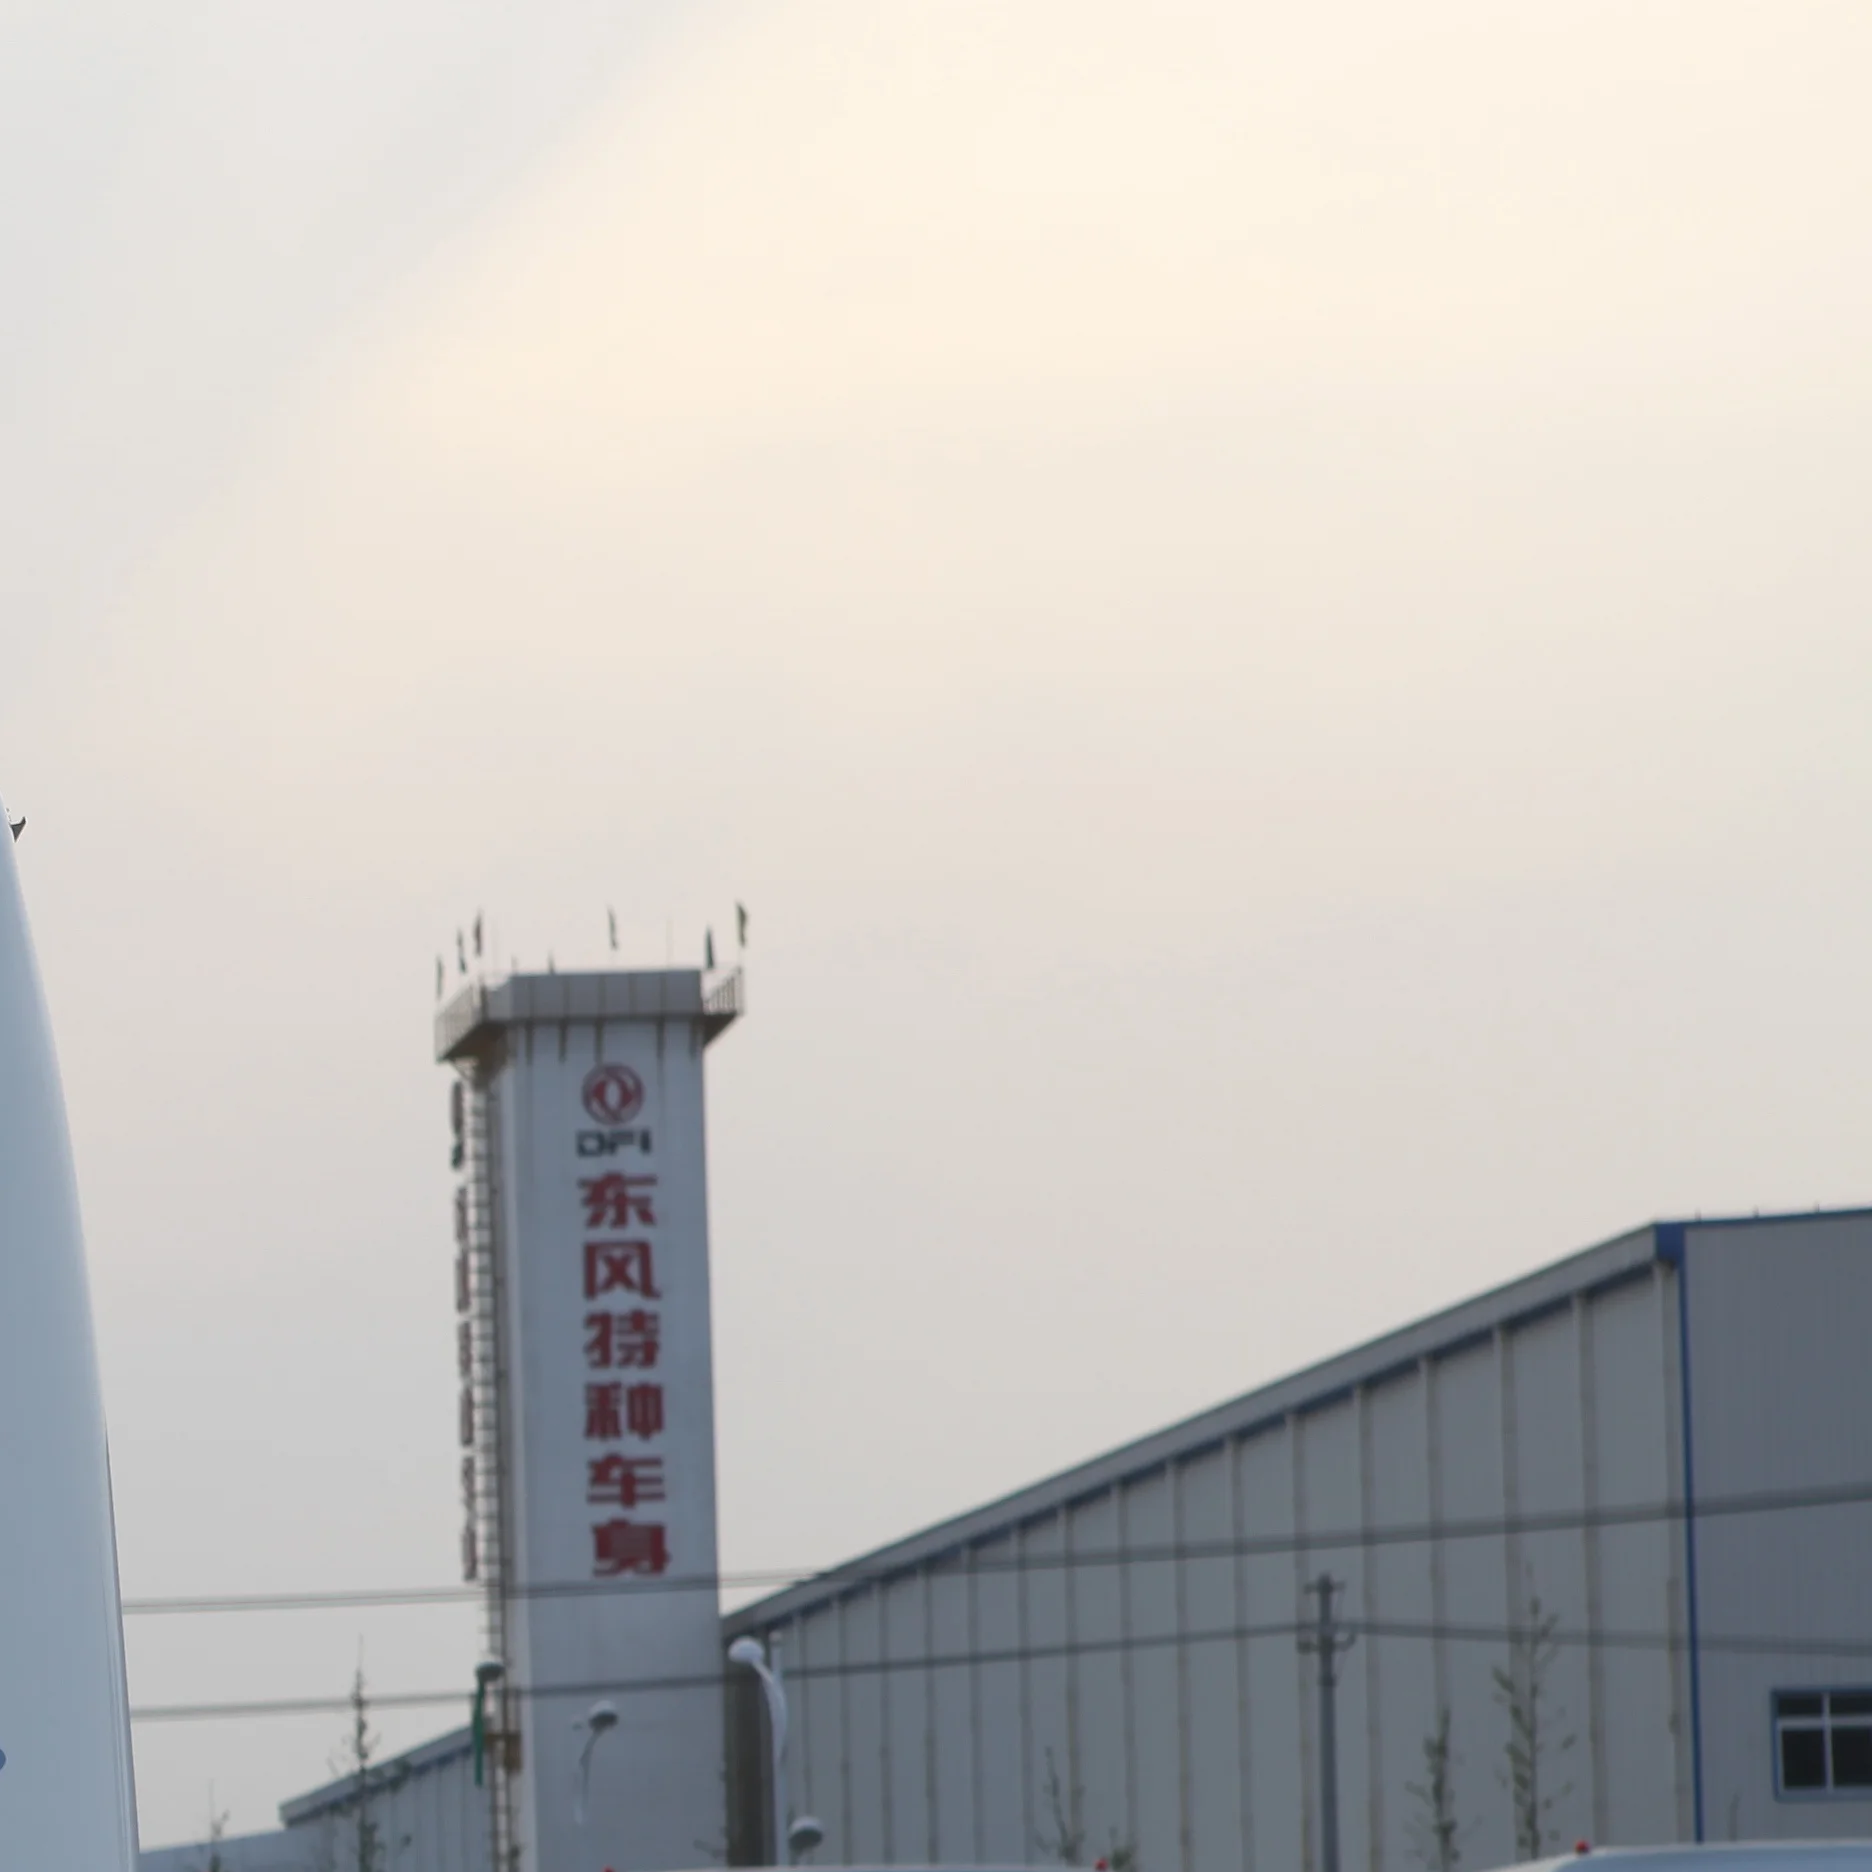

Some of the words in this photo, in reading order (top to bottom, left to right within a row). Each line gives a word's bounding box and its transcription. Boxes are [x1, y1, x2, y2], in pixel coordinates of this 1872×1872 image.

[577, 1170, 670, 1578] 东风特种车身
